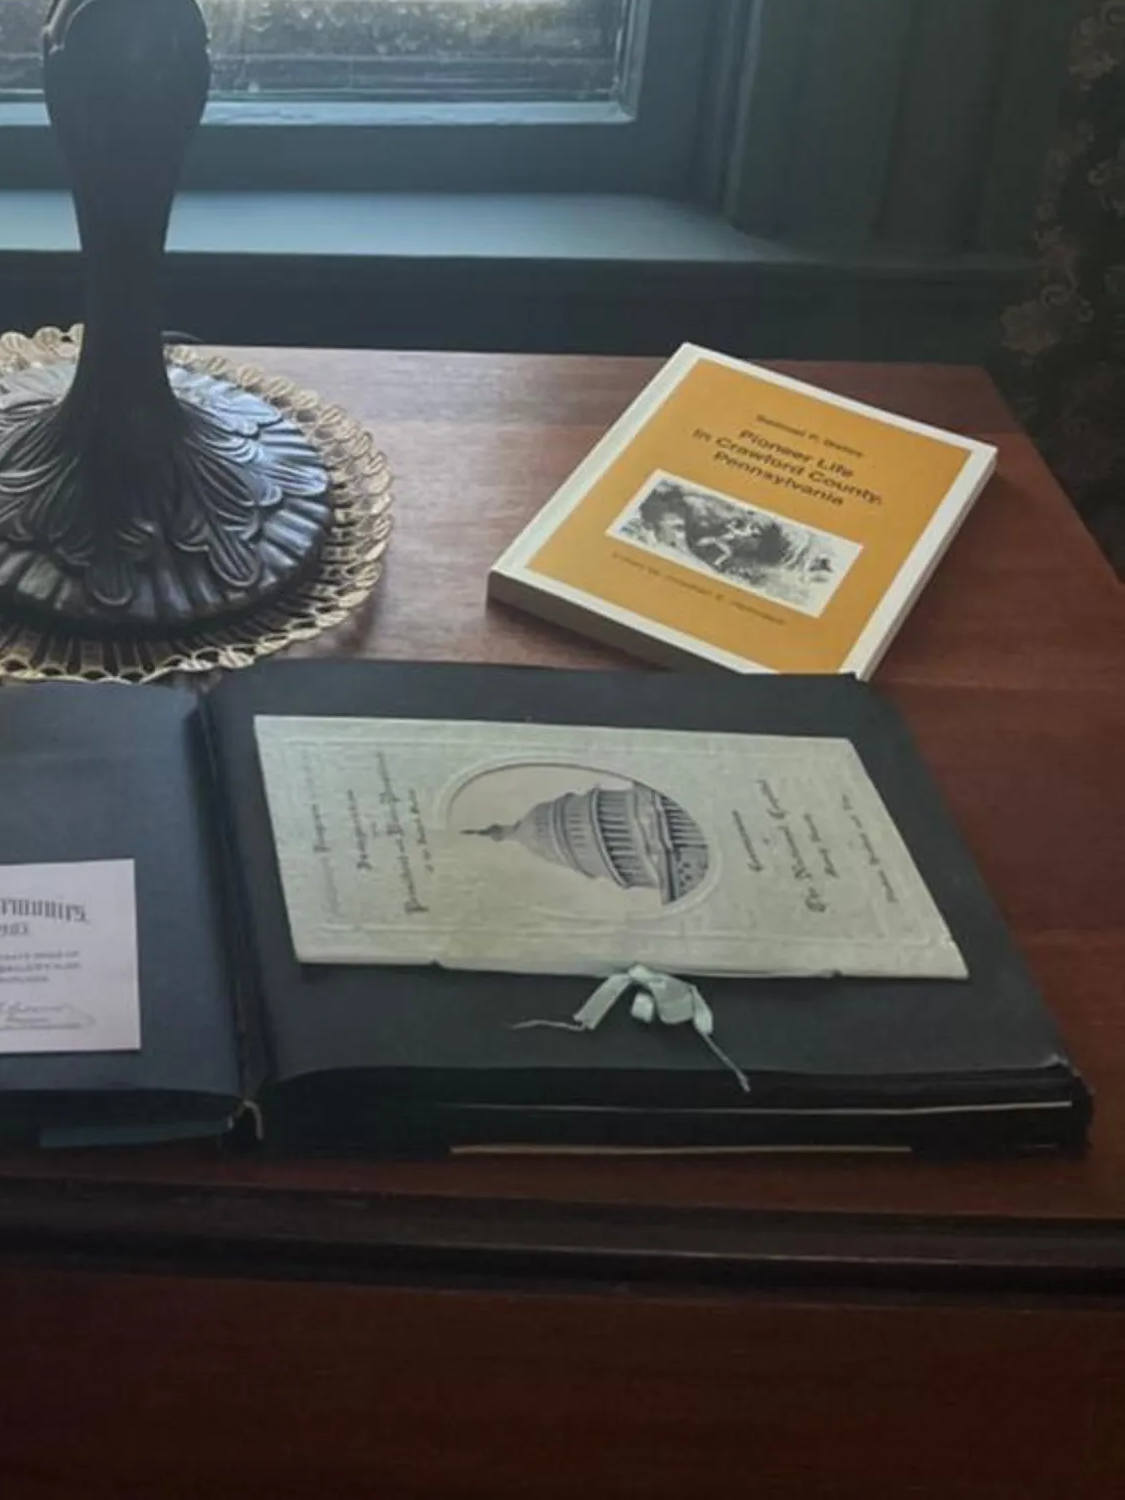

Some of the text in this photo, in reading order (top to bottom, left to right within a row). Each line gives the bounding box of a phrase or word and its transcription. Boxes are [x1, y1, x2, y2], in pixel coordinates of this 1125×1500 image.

[715, 436, 805, 476] Crawford
[739, 429, 813, 462] Pioneer
[817, 458, 854, 478] Life
[714, 451, 844, 506] Pennsylvania
